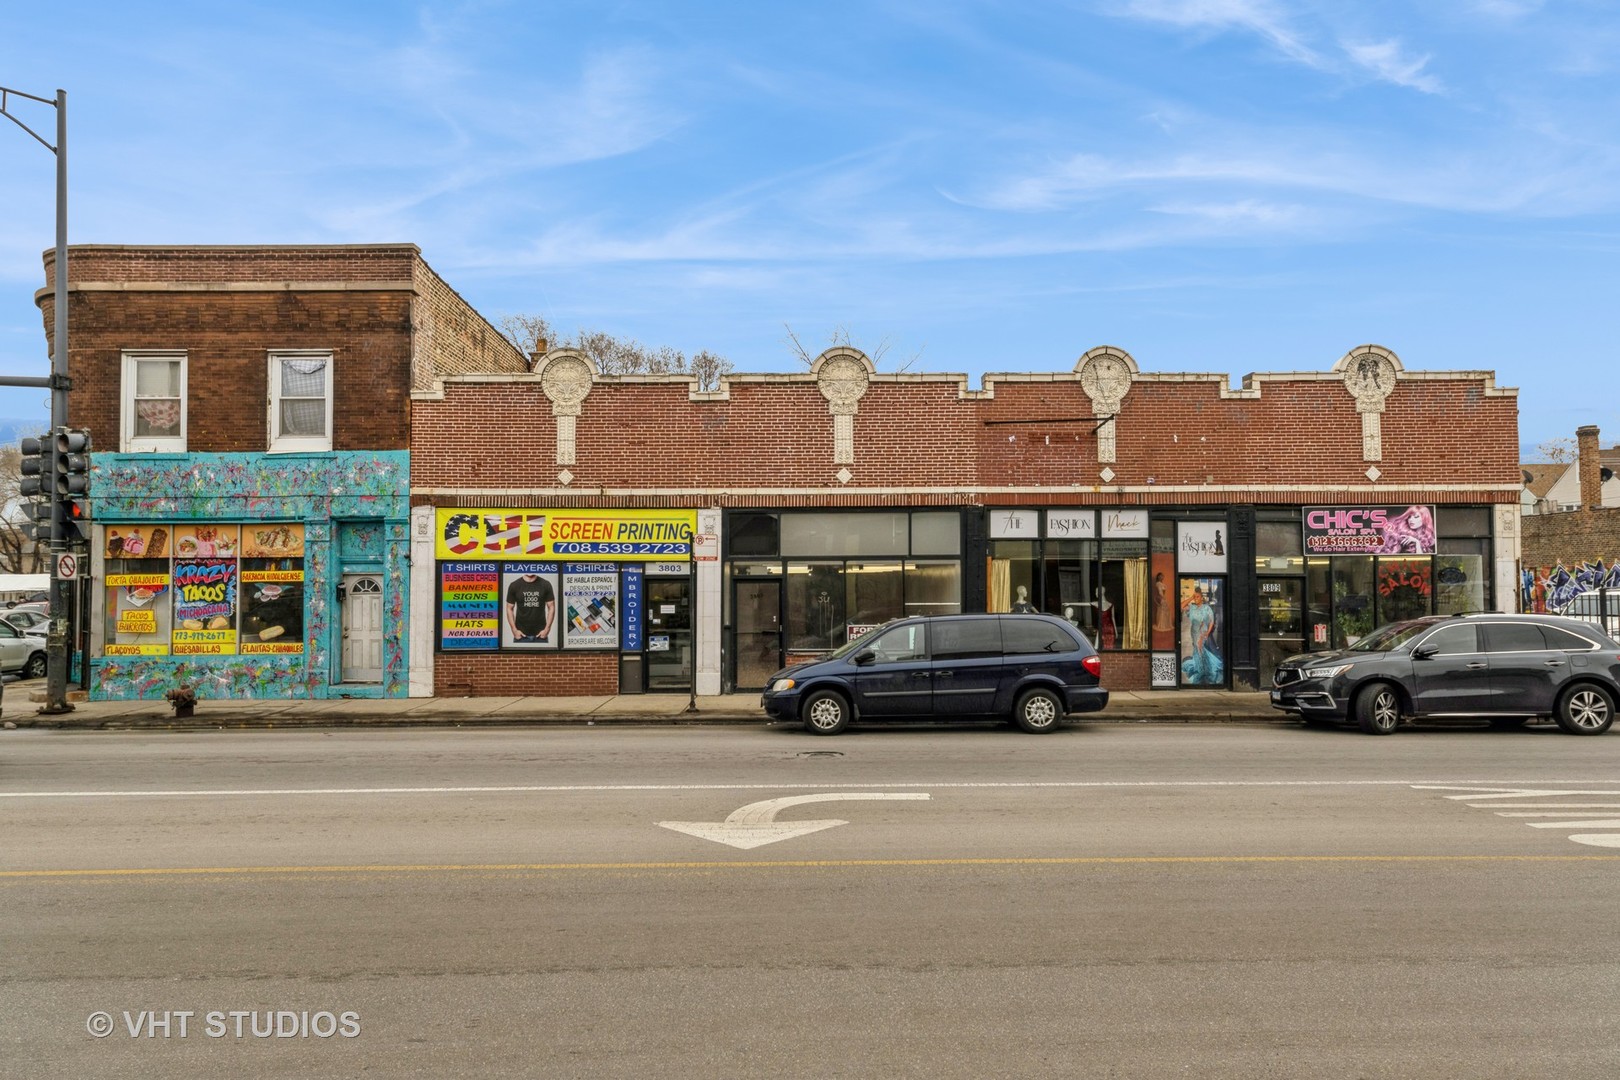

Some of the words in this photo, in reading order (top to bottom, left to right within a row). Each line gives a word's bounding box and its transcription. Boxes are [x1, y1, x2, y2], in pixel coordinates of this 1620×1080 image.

[1307, 510, 1388, 529] CHIC'S
[549, 522, 614, 540] SCREEN
[617, 522, 691, 540] PRINTING
[1050, 519, 1091, 536] FASHION
[444, 513, 546, 555] CHI
[556, 542, 687, 554] 708.539.2723
[446, 563, 454, 571] T
[456, 563, 496, 571] SHIRTS
[504, 564, 558, 572] PLAYERAS
[566, 564, 574, 572] T
[576, 564, 616, 572] SHIRTS
[176, 564, 236, 586] KRAZY
[445, 574, 475, 582] BUSINESS
[476, 574, 497, 582] CARDS
[591, 575, 613, 583] ESPAÑOL
[107, 577, 127, 585] TORTA
[182, 583, 226, 602] TACOS
[179, 603, 228, 618] MICHOACANA
[628, 567, 637, 648] EMBROIDERY
[126, 611, 149, 619] TACOS
[455, 620, 484, 628] HATS
[450, 638, 492, 646] DECALS
[106, 646, 141, 655] TLACOYOS
